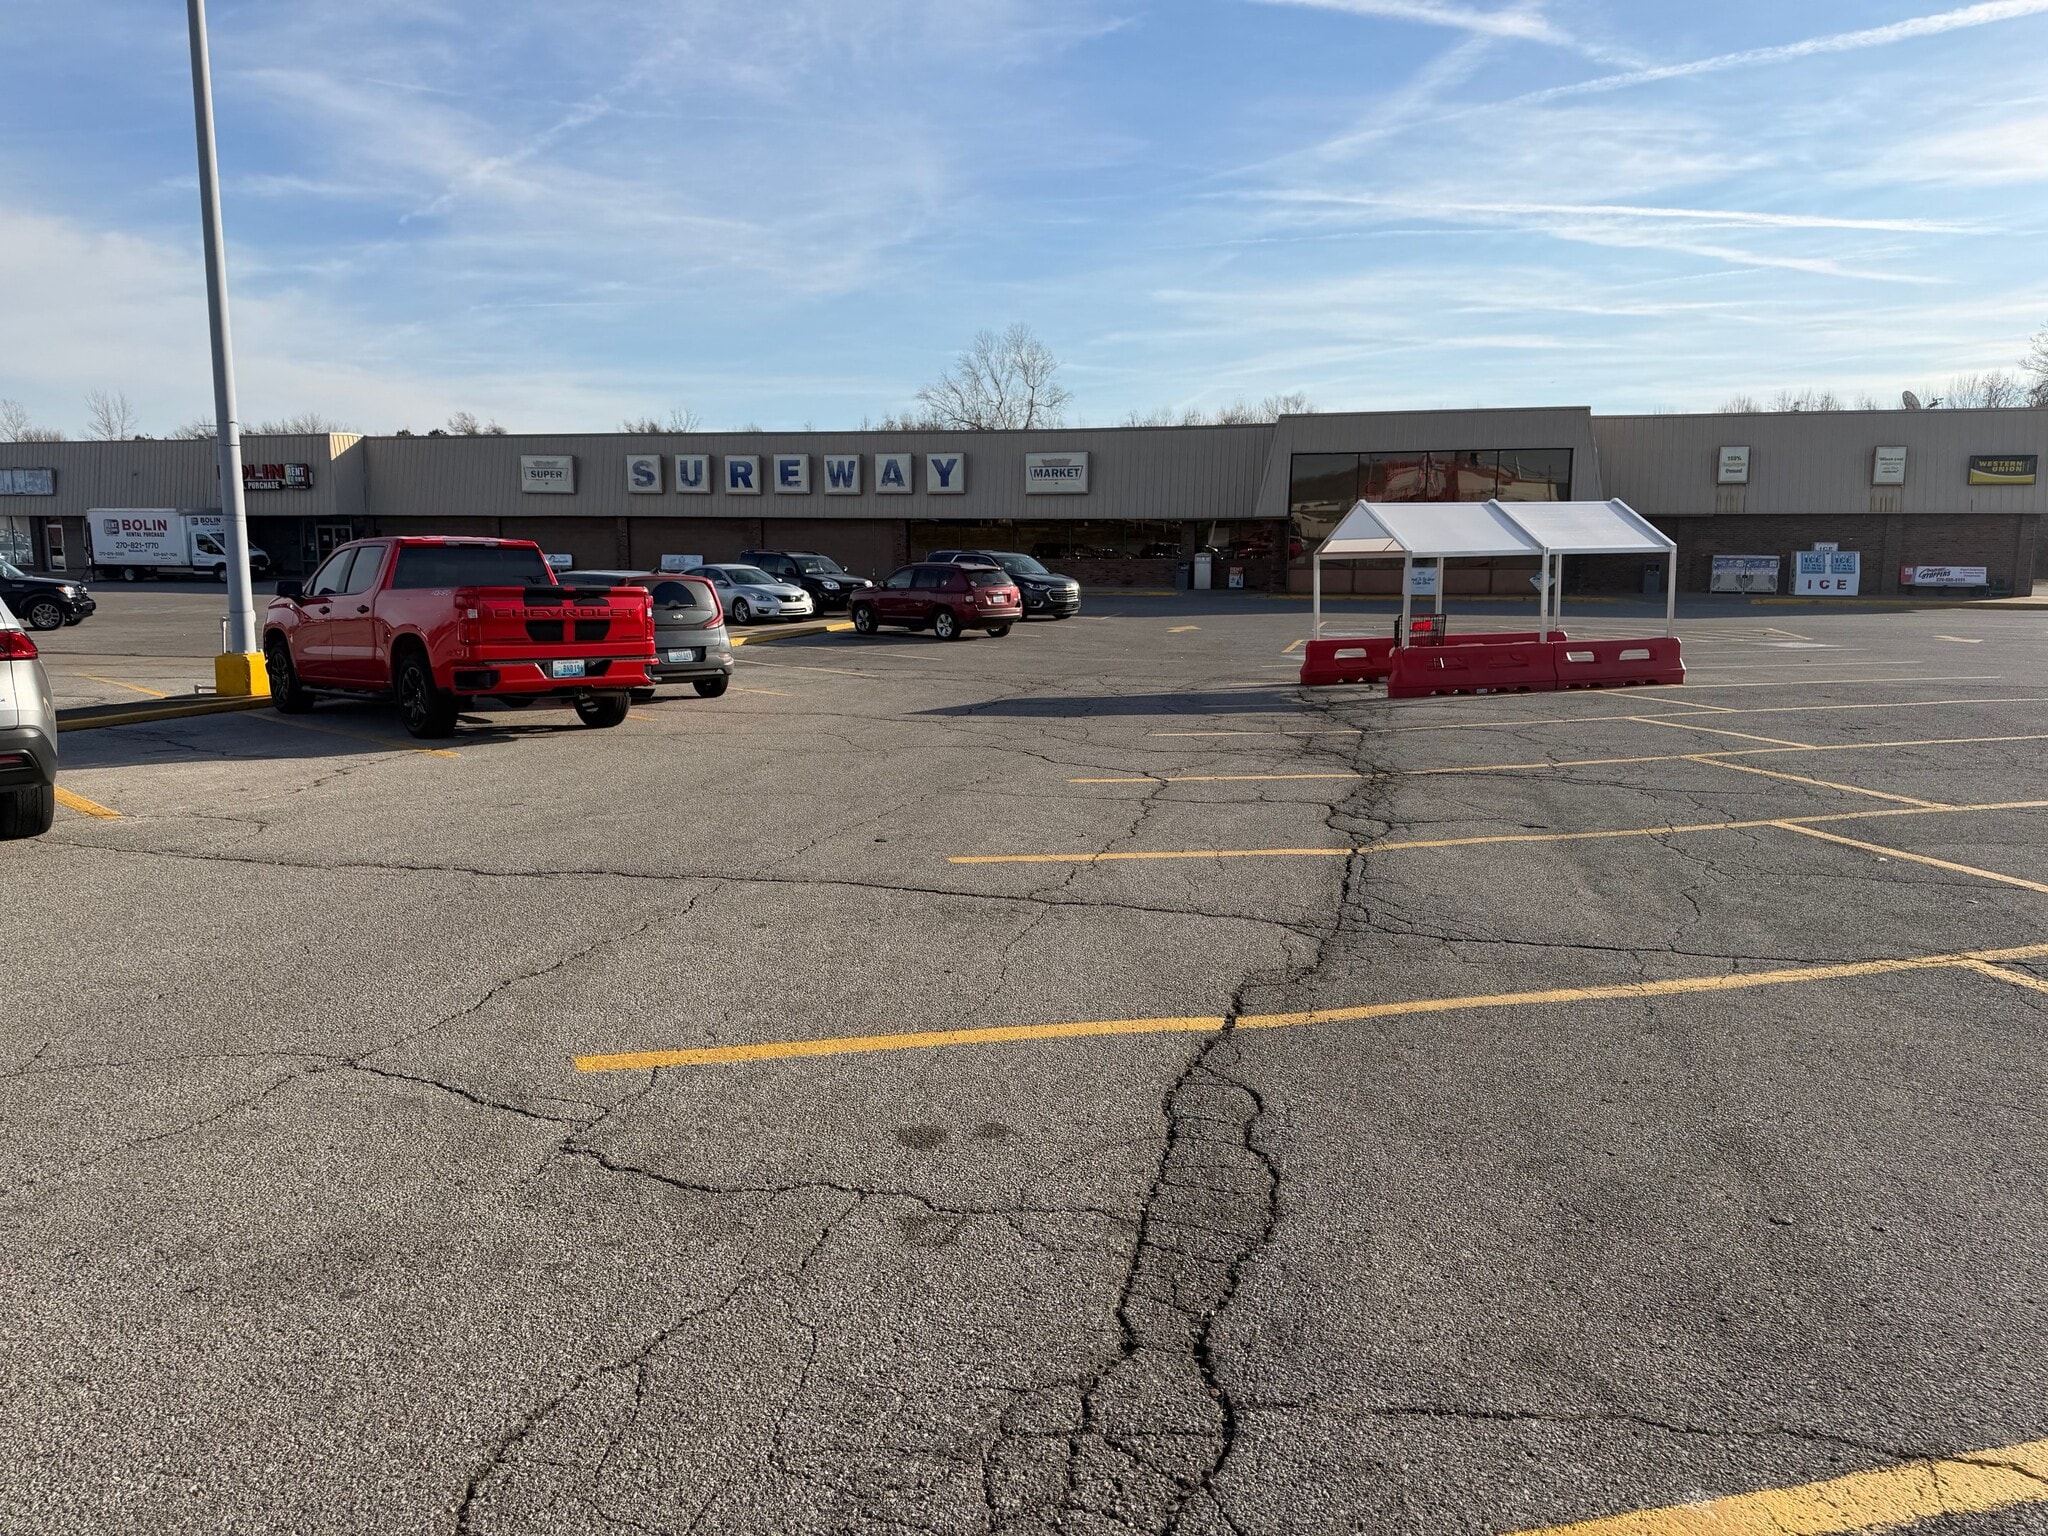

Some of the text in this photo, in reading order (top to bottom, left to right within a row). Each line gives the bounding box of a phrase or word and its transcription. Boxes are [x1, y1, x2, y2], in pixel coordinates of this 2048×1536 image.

[286, 467, 304, 476] RENT
[530, 470, 562, 479] SUPER
[631, 457, 959, 488] SUREWAY
[1033, 468, 1080, 478] MARKET
[247, 481, 280, 490] PURCHASE
[122, 519, 167, 531] BOLIN
[115, 541, 159, 550] 270-821-1770
[1804, 553, 1822, 563] ICE
[1835, 553, 1853, 563] ICE
[1807, 578, 1847, 590] ICE
[493, 607, 636, 619] CHEVROLET
